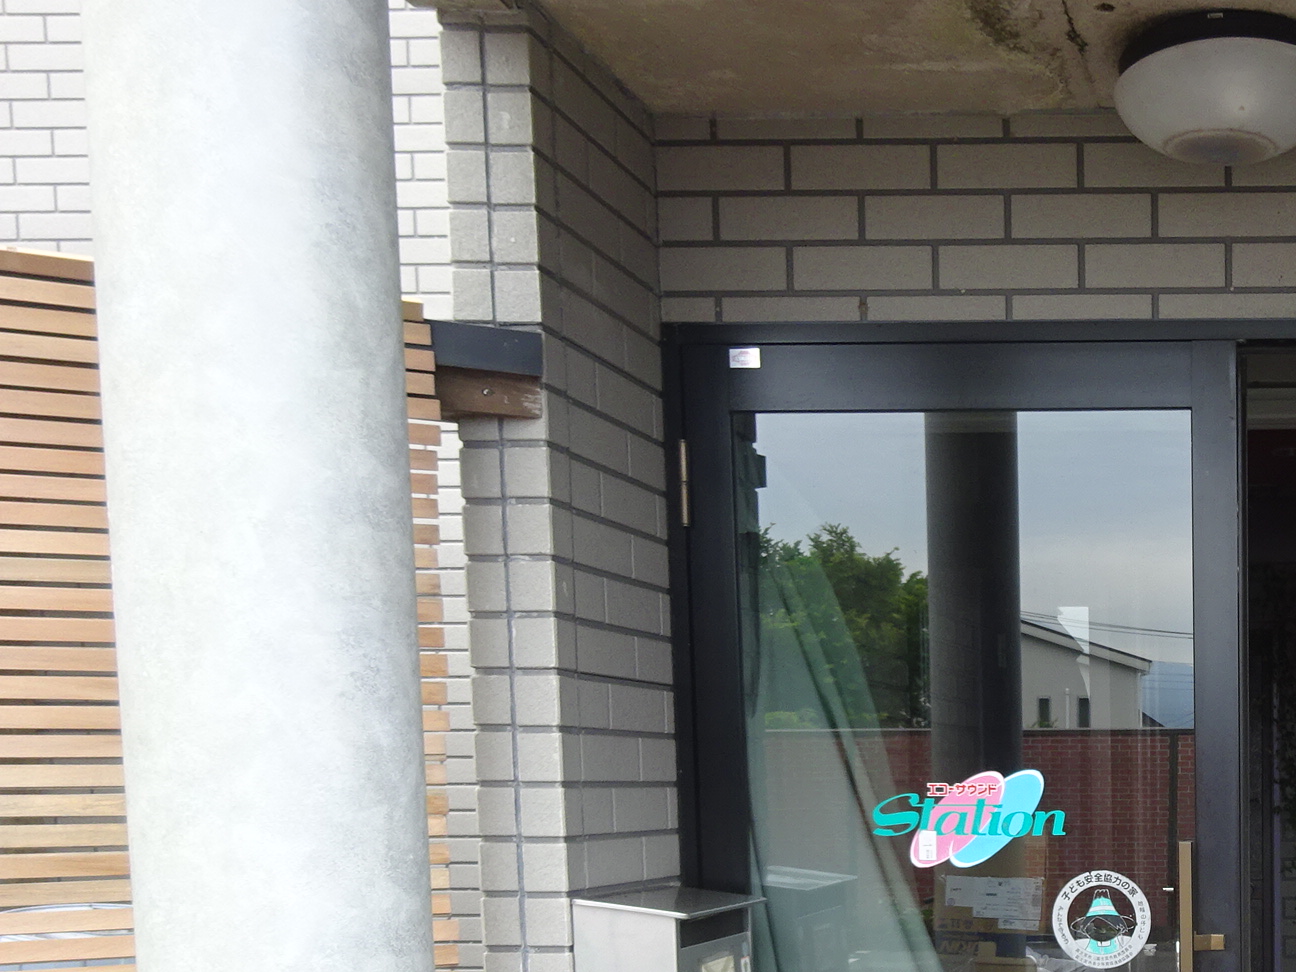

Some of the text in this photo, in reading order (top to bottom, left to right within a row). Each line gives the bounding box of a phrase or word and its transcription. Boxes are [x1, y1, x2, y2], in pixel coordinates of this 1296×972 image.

[927, 783, 998, 796] エコーサウンド
[872, 792, 1067, 838] Station
[1061, 872, 1139, 901] 子ども安全協力の家
